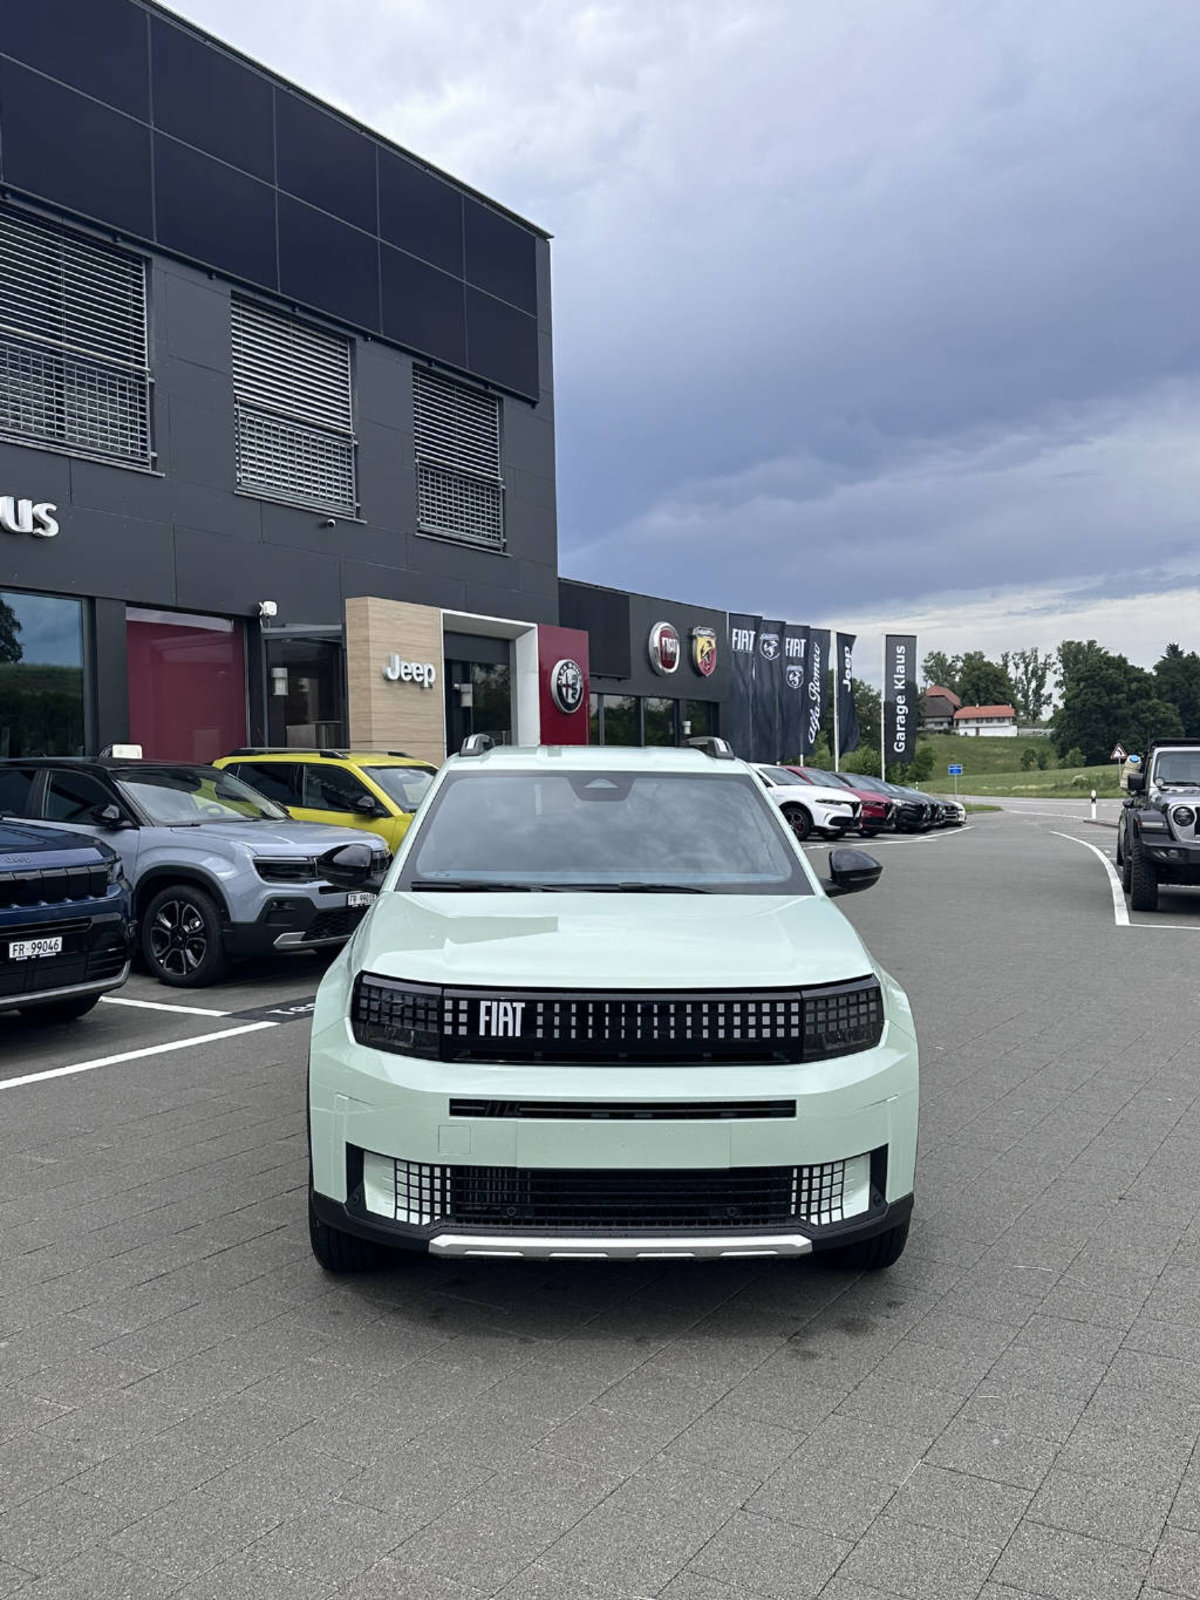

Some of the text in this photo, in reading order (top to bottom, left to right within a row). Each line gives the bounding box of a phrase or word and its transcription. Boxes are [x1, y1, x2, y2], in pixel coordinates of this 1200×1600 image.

[732, 628, 756, 652] FIAT
[785, 637, 806, 658] FIAT
[382, 653, 436, 688] Jeep
[808, 642, 821, 744] Alfa Romeo
[893, 645, 908, 753] Garage Klaus
[12, 944, 26, 956] FR
[31, 939, 60, 954] 99046
[479, 1000, 526, 1037] FIAT
